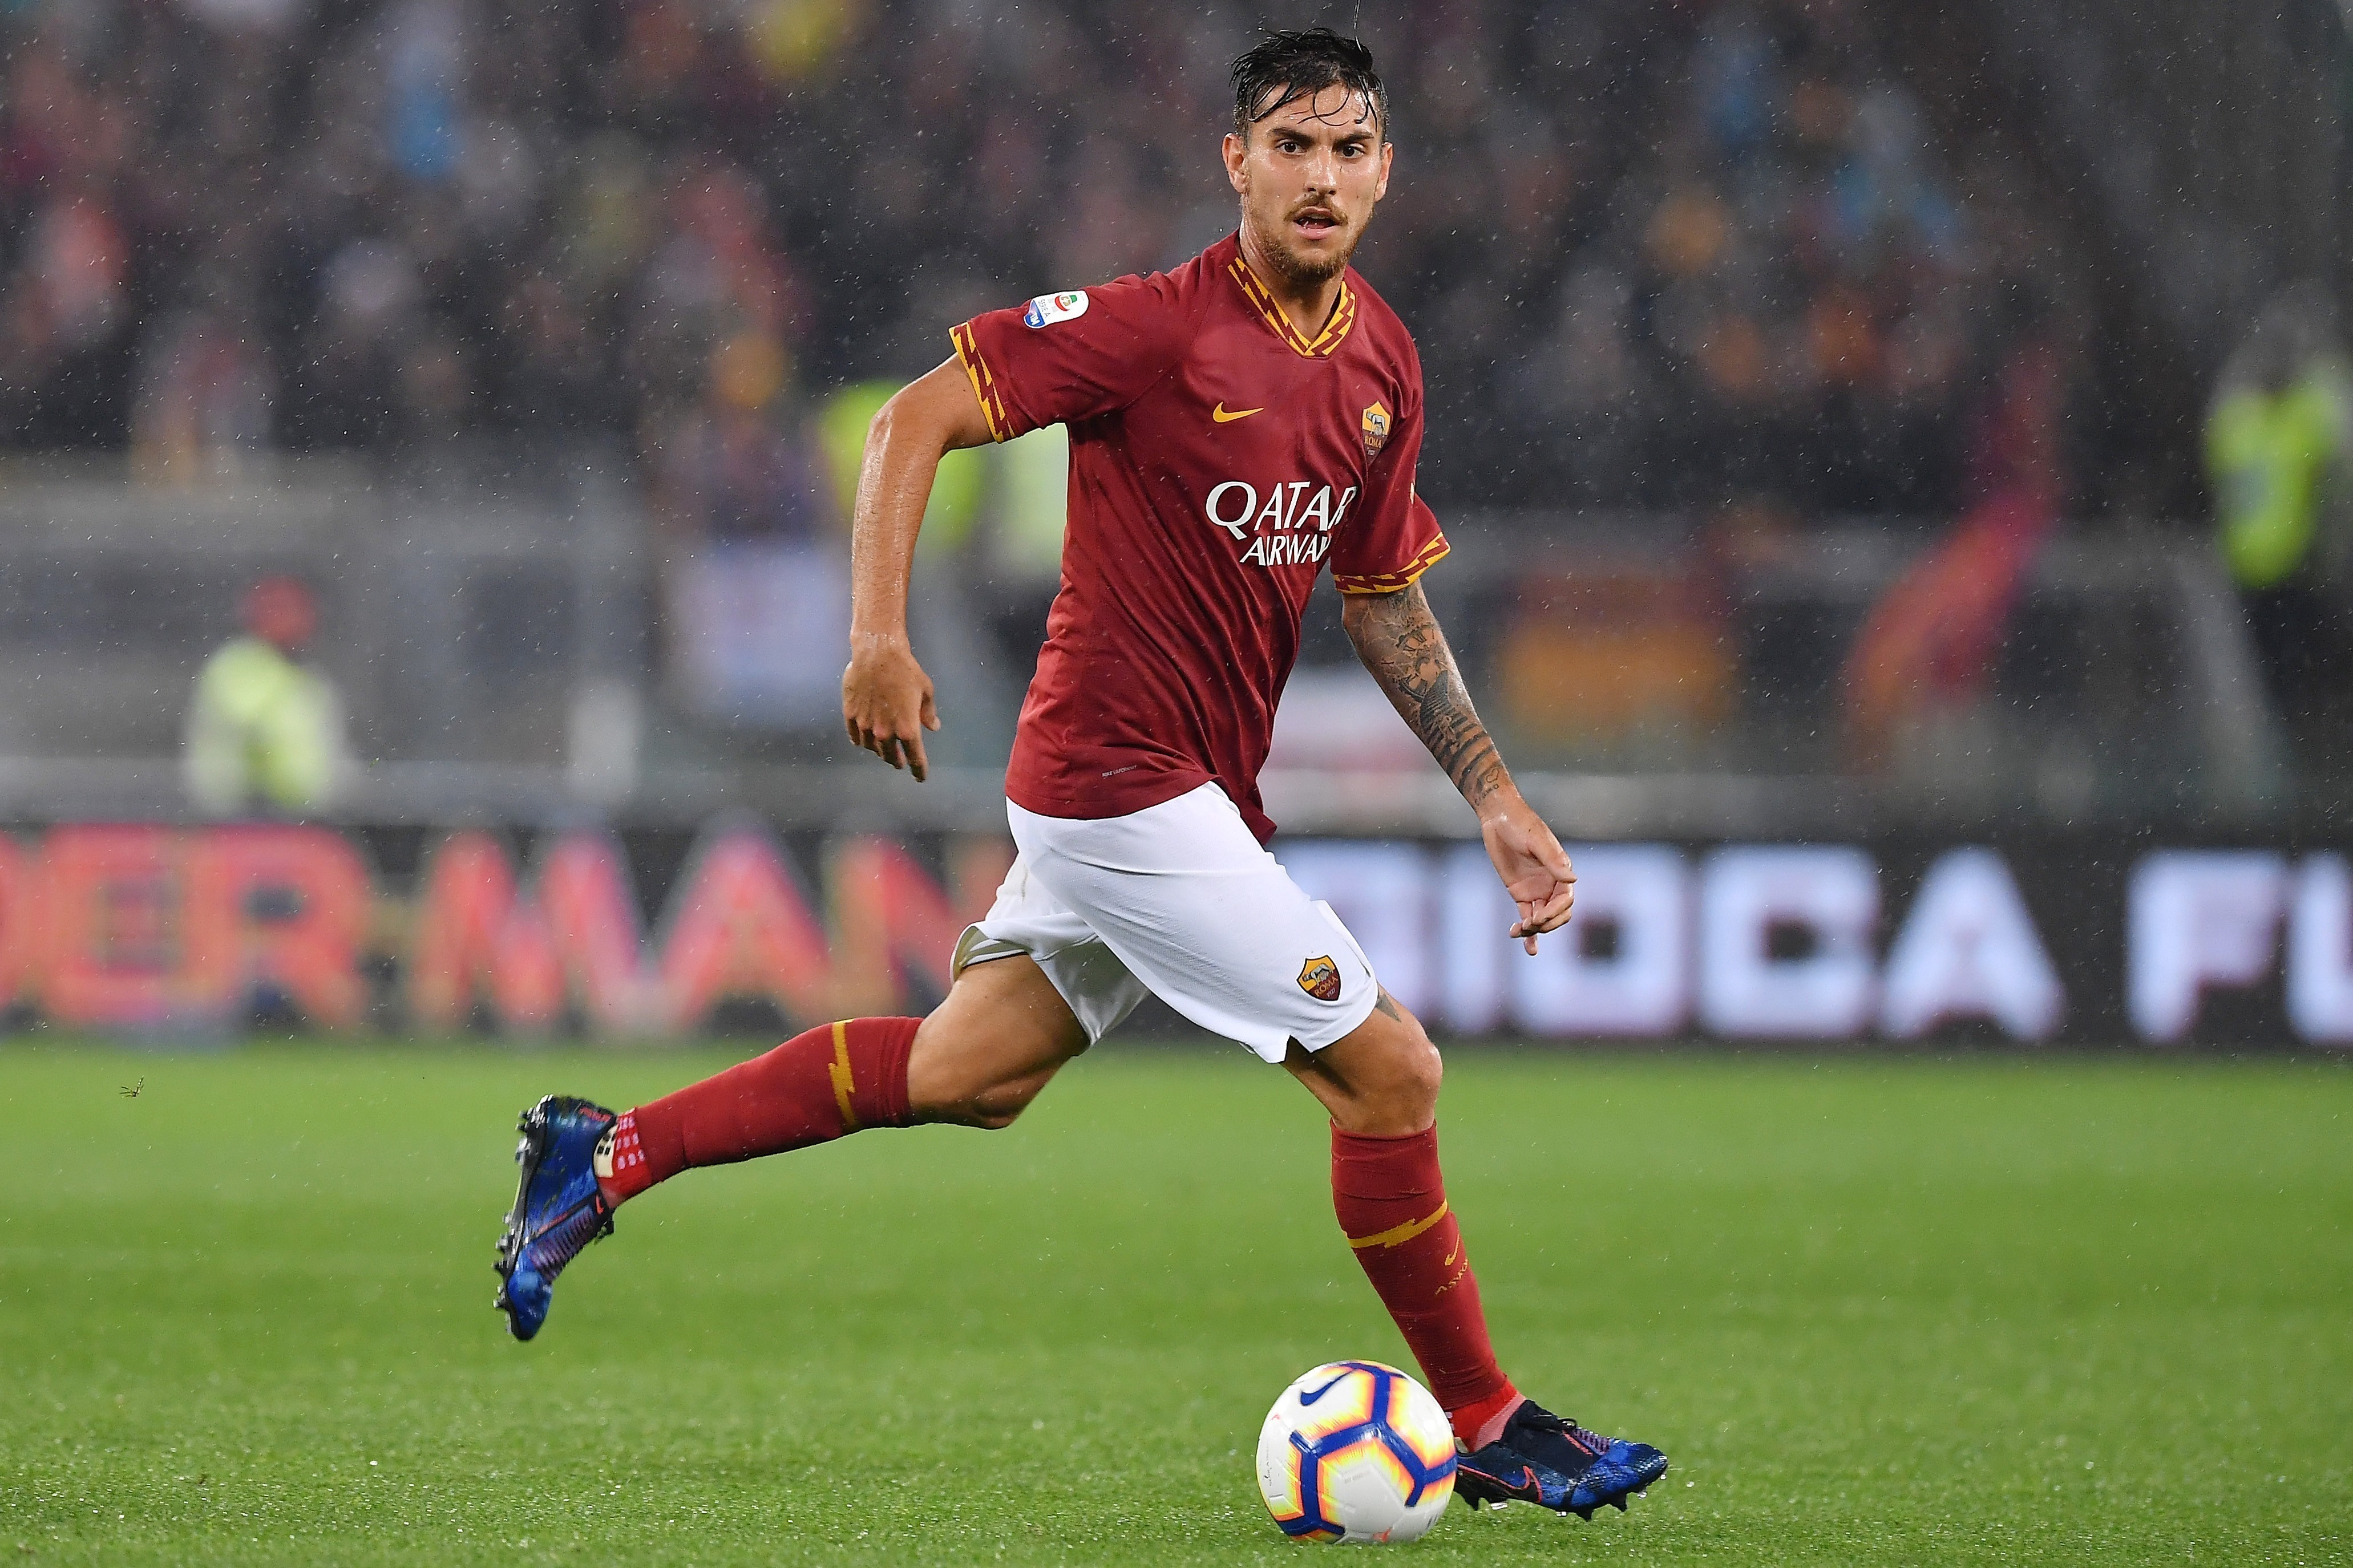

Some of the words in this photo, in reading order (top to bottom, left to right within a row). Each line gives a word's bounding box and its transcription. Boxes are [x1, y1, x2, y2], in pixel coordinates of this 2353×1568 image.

[1364, 435, 1382, 448] ROMA
[1206, 481, 1357, 540] QATAR
[1314, 976, 1339, 996] ROMA
